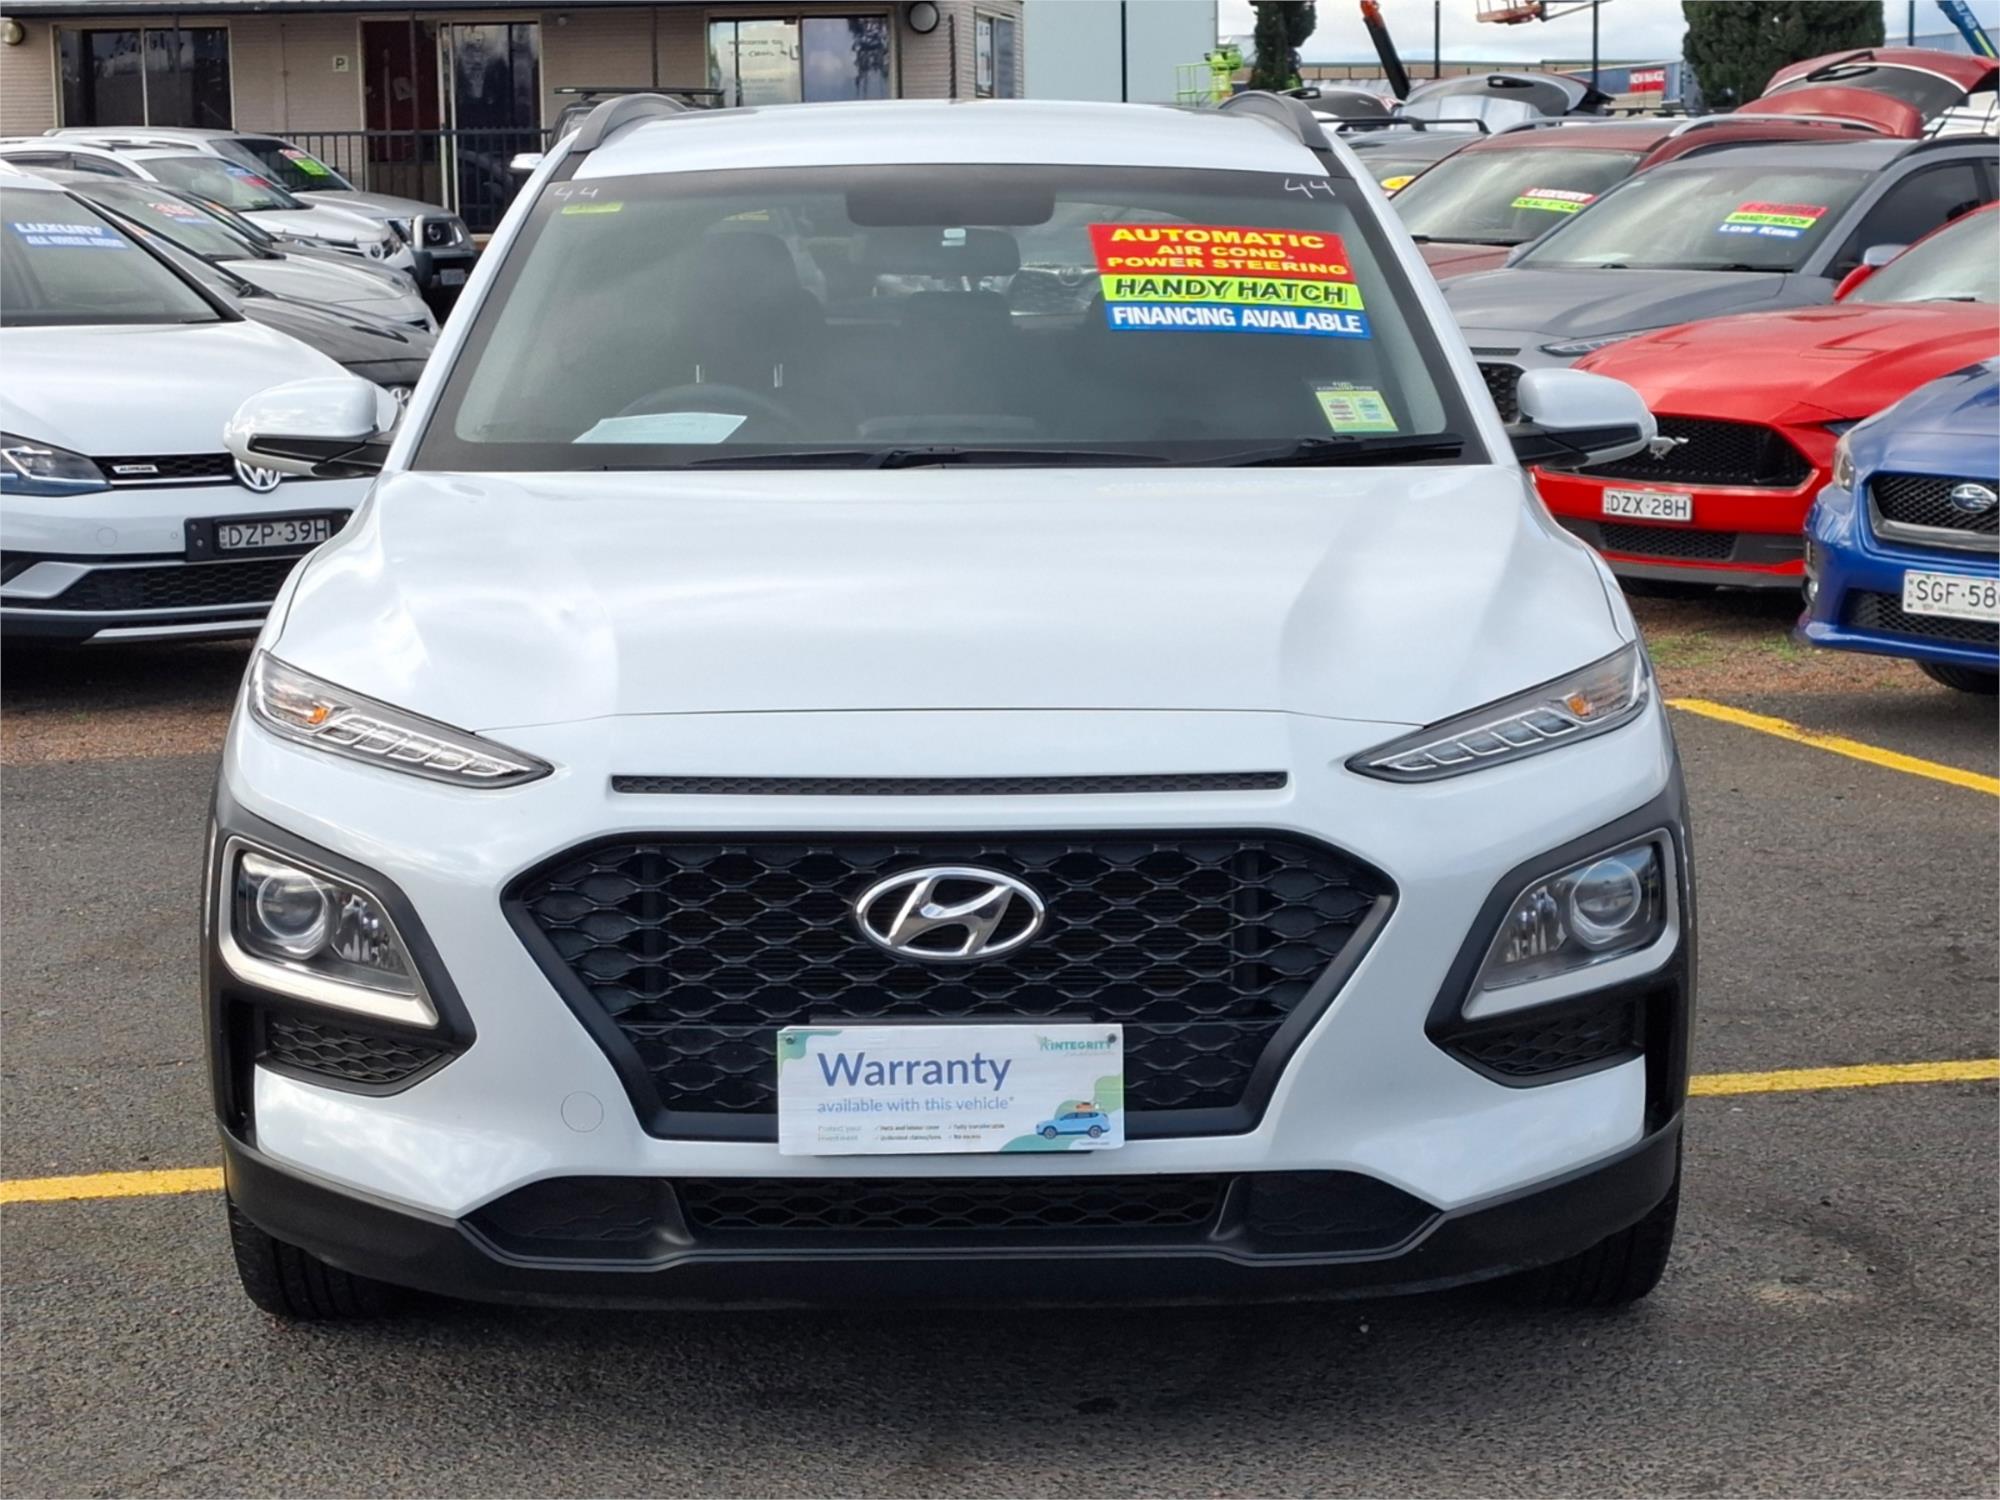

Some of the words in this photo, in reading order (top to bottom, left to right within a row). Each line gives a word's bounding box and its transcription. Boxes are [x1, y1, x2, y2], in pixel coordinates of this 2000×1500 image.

[554, 187, 599, 202] 44
[1284, 178, 1336, 199] 44
[14, 221, 103, 236] LUXURY
[1111, 228, 1326, 249] AUTOMATIC
[1157, 245, 1204, 256] AIR
[1211, 247, 1295, 260] COND.
[1107, 257, 1205, 269] POWER
[1211, 258, 1349, 275] STEERING
[1115, 278, 1232, 300] HANDY
[1237, 281, 1348, 305] HATCH
[1112, 306, 1237, 327] FINANCING
[1241, 310, 1364, 334] AVAILABLE
[816, 1051, 1013, 1092] Warranty
[816, 1098, 883, 1114] available
[886, 1098, 920, 1112] with
[924, 1098, 952, 1112] this
